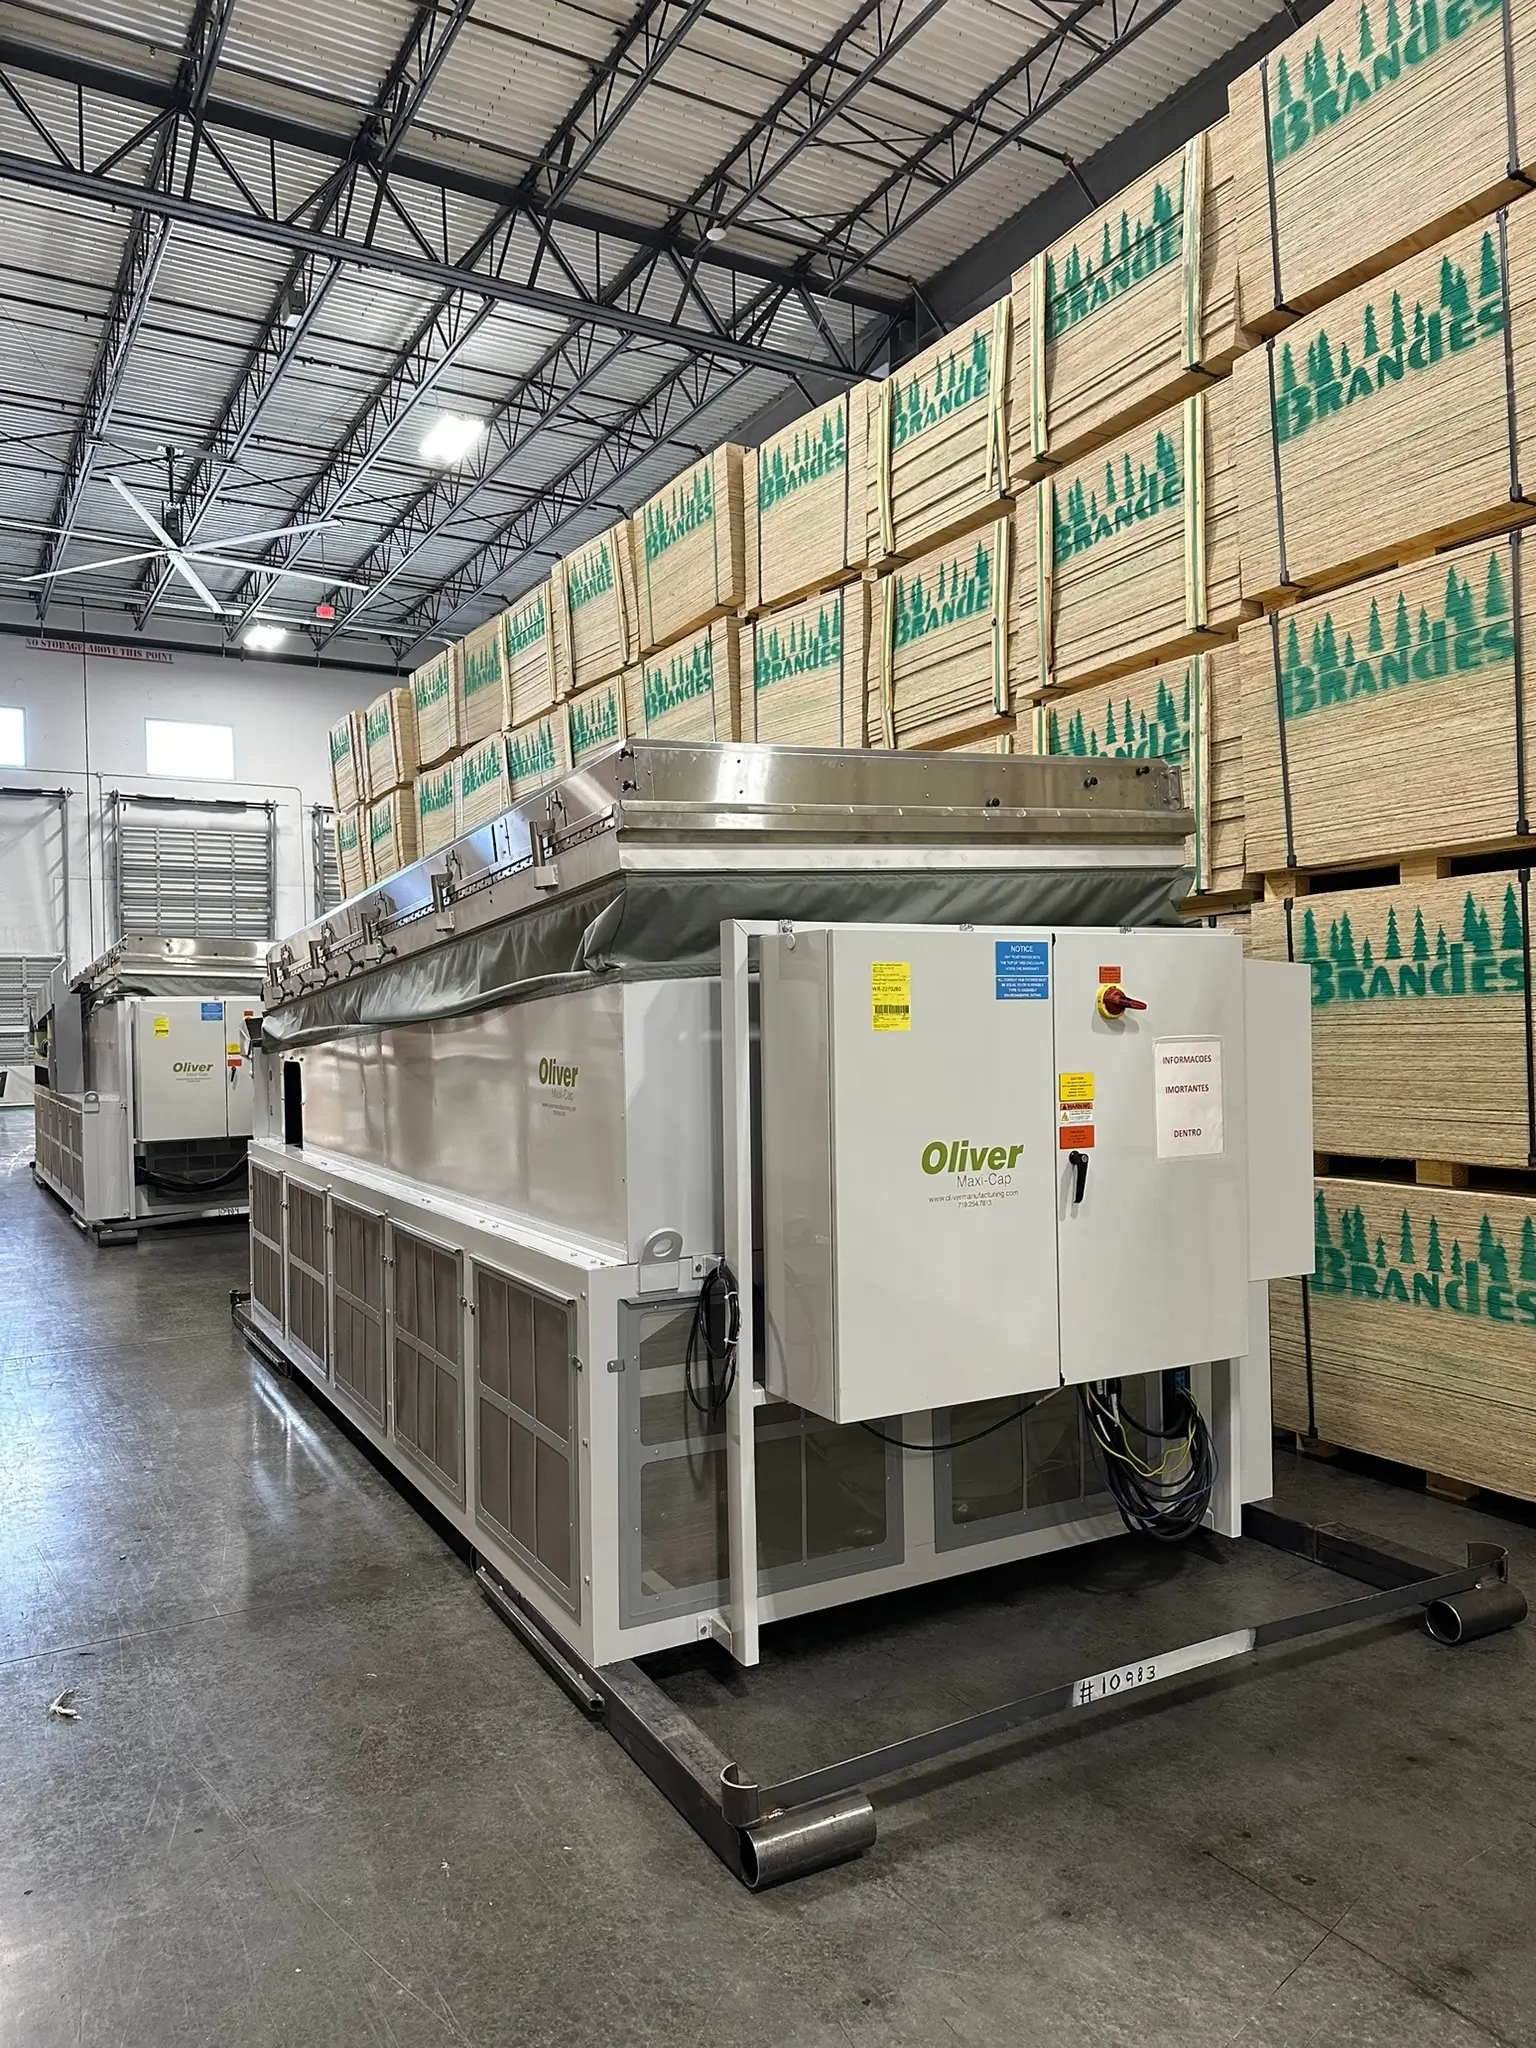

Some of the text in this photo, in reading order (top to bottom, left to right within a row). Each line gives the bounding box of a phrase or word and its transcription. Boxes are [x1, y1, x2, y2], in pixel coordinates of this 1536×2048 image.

[1051, 472, 1184, 568] BRANdE
[25, 637, 173, 661] NO STORAGE ABOVE THIS POINT
[1010, 945, 1034, 953] NOTICE
[172, 1062, 213, 1073] Oliver
[1162, 1054, 1212, 1065] INFORMACOES
[539, 1057, 578, 1087] Oliver
[1165, 1084, 1209, 1095] IMORTANTES
[1173, 1128, 1202, 1138] DENTRO
[921, 1139, 1025, 1175] Oliver
[957, 1172, 1012, 1188] Maxi-Cap
[1079, 1665, 1156, 1703] #10983
